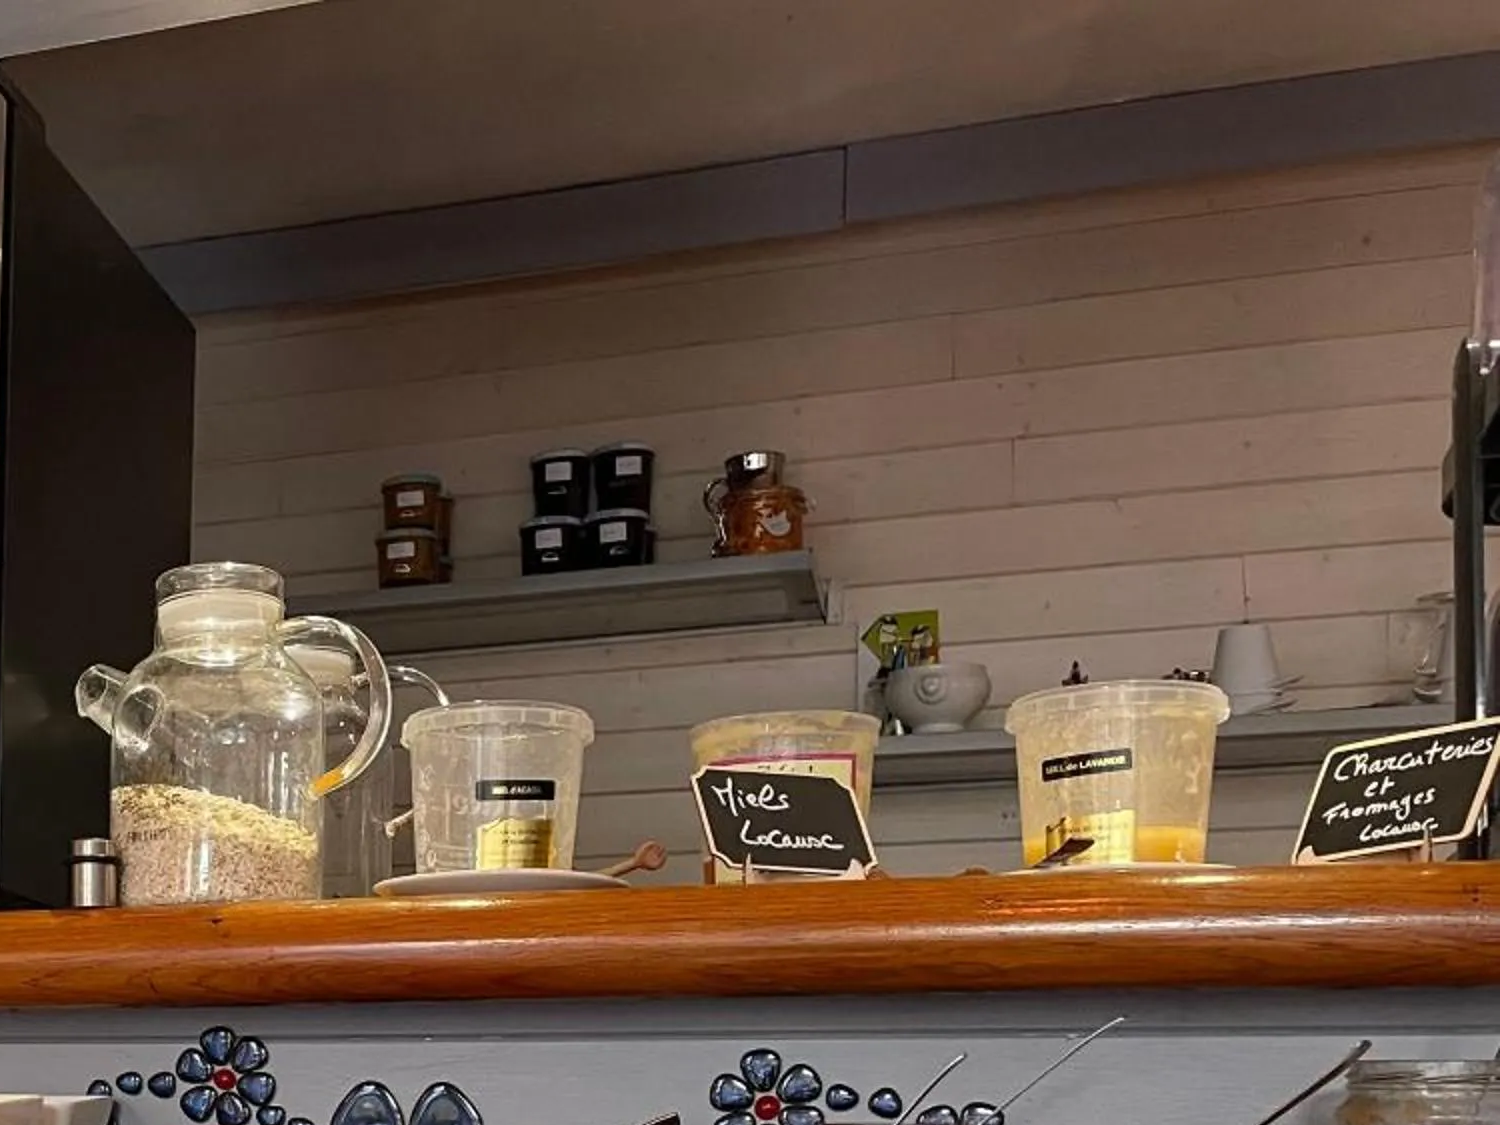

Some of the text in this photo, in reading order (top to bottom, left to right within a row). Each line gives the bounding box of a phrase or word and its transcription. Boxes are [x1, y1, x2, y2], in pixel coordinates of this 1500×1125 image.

[1334, 736, 1494, 781] Charcuteries
[711, 777, 790, 816] Miels
[1364, 776, 1395, 797] et
[1322, 788, 1436, 824] Fromages
